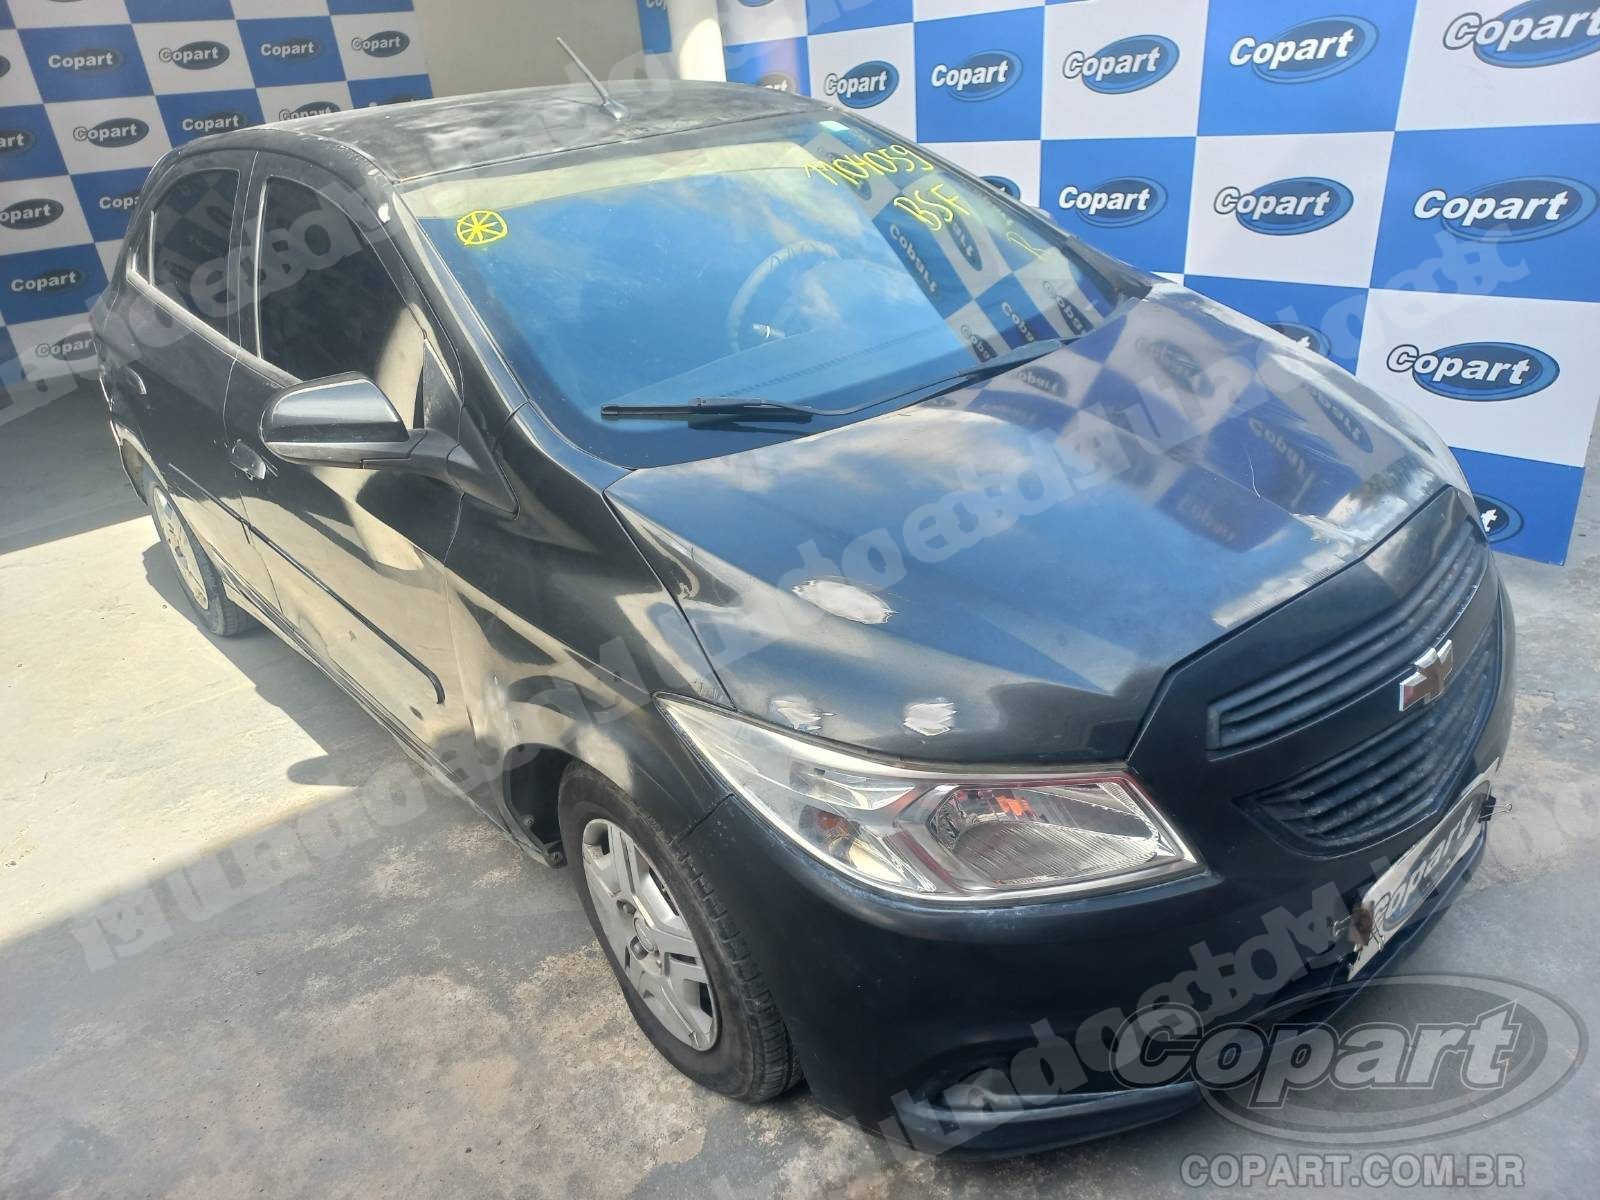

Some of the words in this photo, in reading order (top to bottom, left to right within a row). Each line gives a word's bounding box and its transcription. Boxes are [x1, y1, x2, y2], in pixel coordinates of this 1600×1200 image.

[1443, 12, 1600, 51] Copart
[260, 41, 315, 58] Copart
[351, 36, 402, 50] Copart
[1229, 28, 1354, 69] Copart
[48, 53, 113, 70] Copart
[159, 46, 219, 62] Copart
[1062, 47, 1161, 81] Copart
[824, 70, 888, 98] Copart
[931, 60, 1009, 91] Copart
[73, 123, 137, 143] Copart
[182, 114, 239, 131] Copart
[0, 133, 25, 147] art
[99, 194, 139, 210] Cop
[1058, 185, 1150, 214] Copart
[1213, 186, 1330, 221] Copart
[1413, 188, 1568, 226] Copart
[0, 203, 51, 224] opart
[11, 270, 77, 292] Copart
[36, 336, 93, 357] Copar
[1387, 344, 1530, 385] Copart
